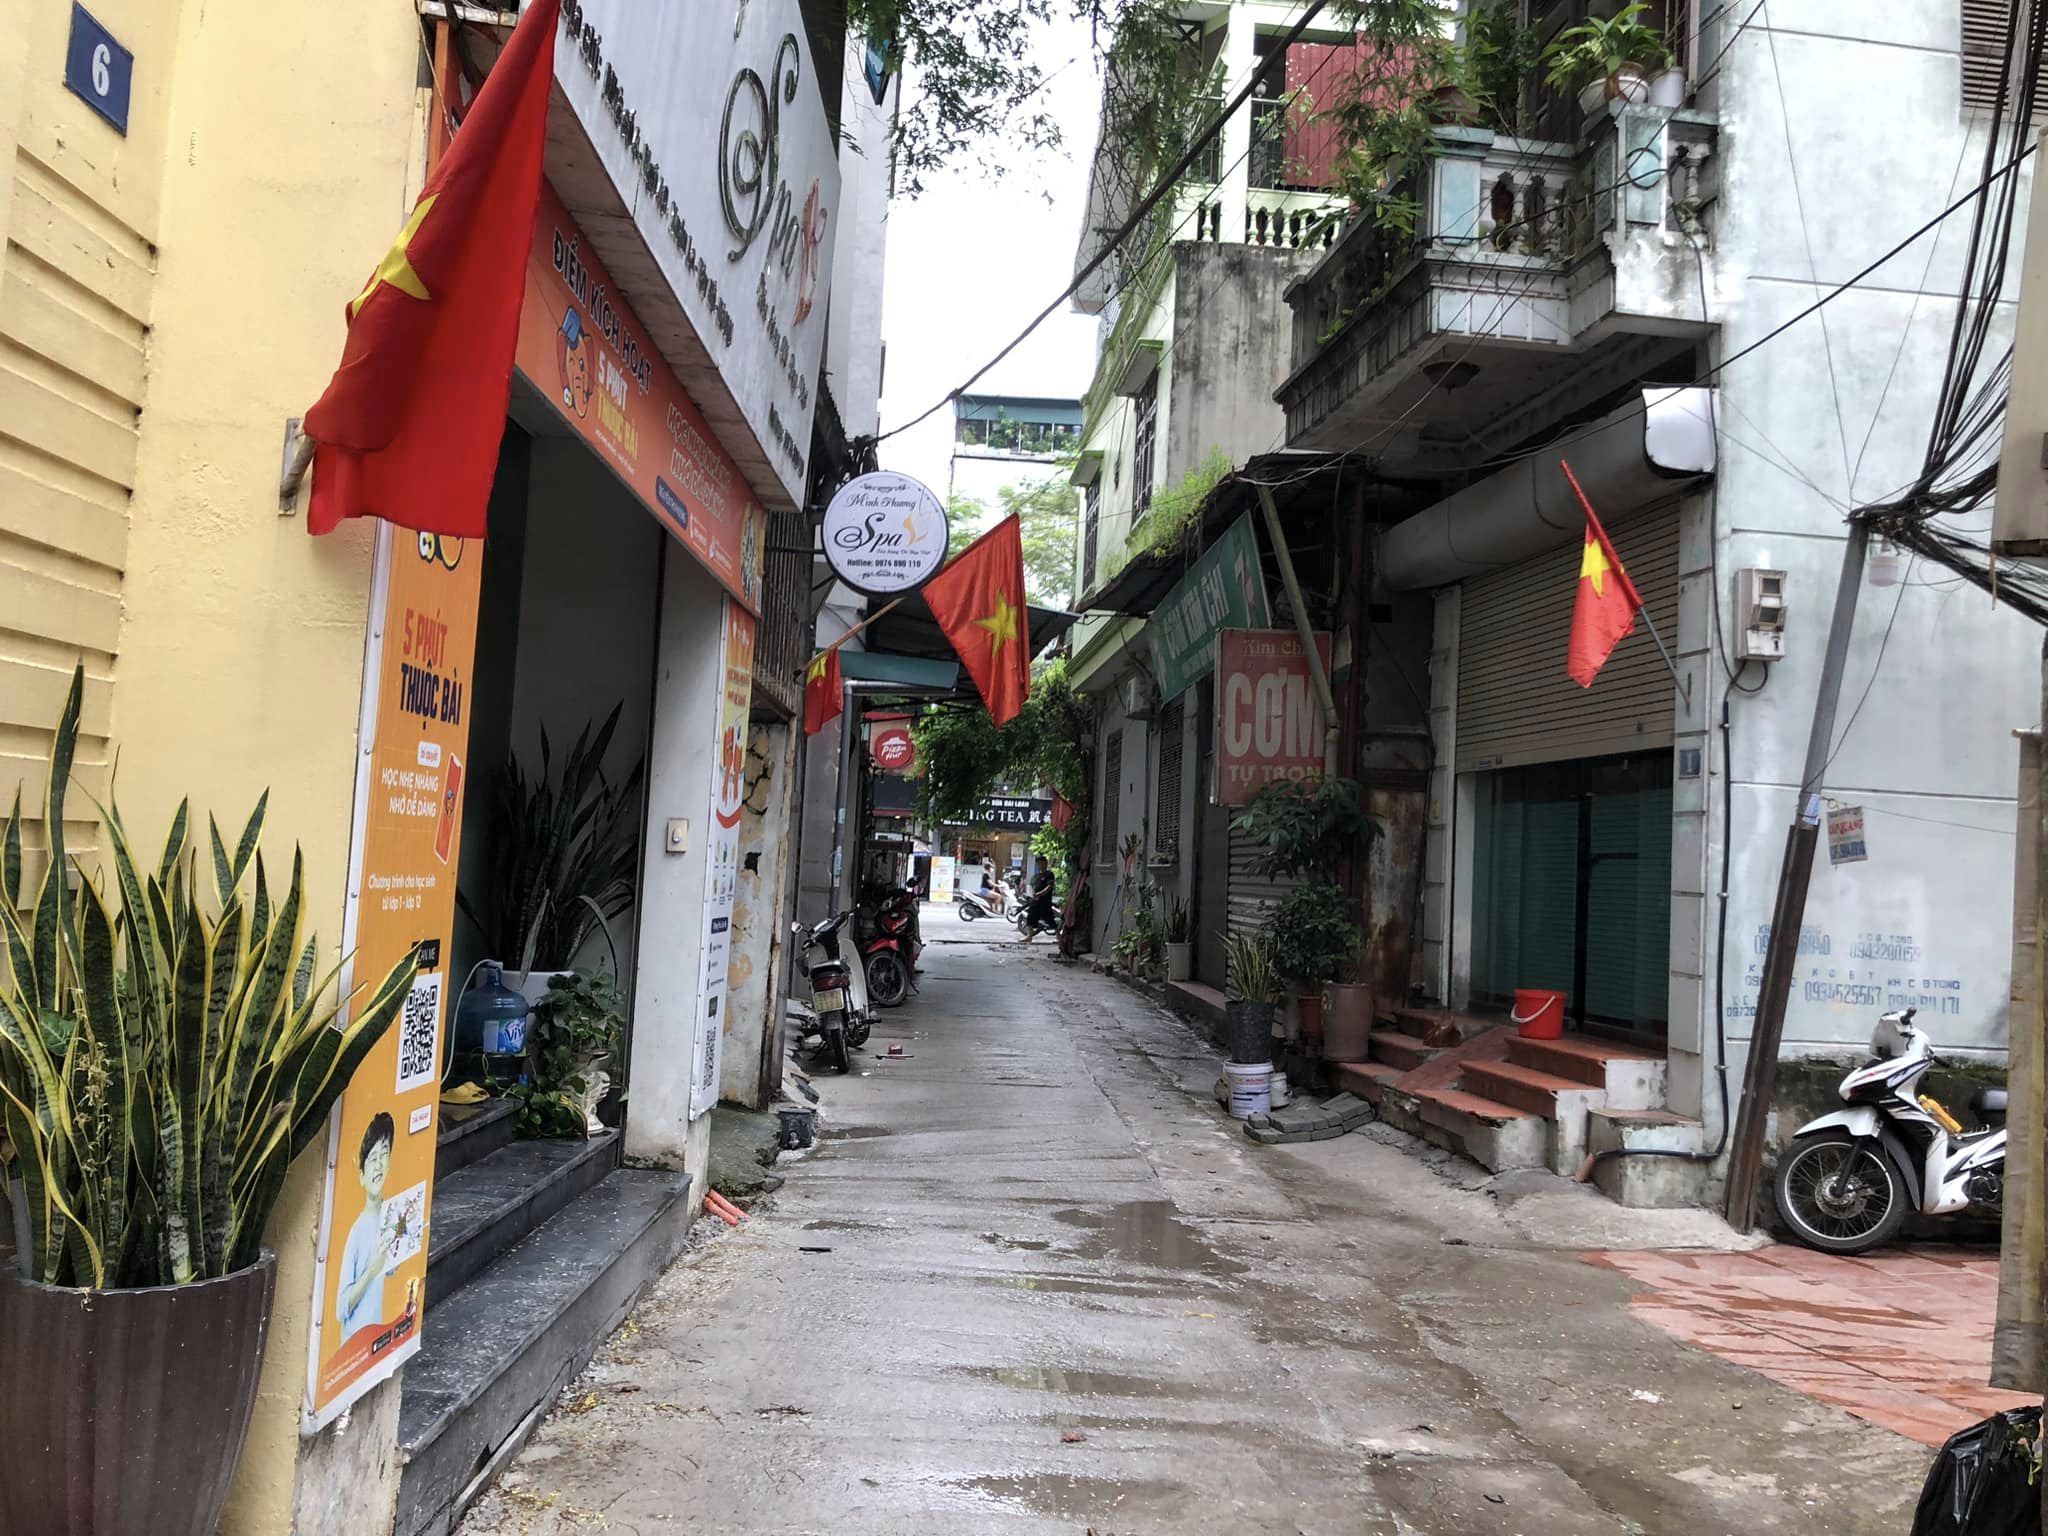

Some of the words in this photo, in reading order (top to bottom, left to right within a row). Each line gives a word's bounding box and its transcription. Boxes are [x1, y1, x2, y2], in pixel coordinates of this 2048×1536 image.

[91, 43, 112, 97] 6
[552, 226, 588, 308] ĐIỂM
[589, 279, 621, 355] KÍCH
[621, 327, 652, 396] HOẠT
[598, 350, 606, 385] 5
[606, 364, 629, 412] PHÚT
[846, 492, 879, 507] Minh
[833, 511, 903, 553] Spa
[403, 608, 414, 655] 5
[415, 608, 448, 668] PHÚT
[1280, 639, 1306, 655] Ch
[400, 658, 440, 731] THUỘC
[441, 667, 463, 726] BÀI
[1224, 666, 1325, 758] CƠM
[881, 745, 907, 757] Pizza
[885, 752, 903, 761] Hut
[381, 767, 399, 789] HỌC
[399, 771, 414, 792] NHẸ
[415, 770, 439, 793] NHÀNG
[389, 793, 406, 815] NHỚ
[407, 791, 417, 816] DỄ
[417, 797, 437, 817] DÀNG
[997, 810, 1024, 823] TEA
